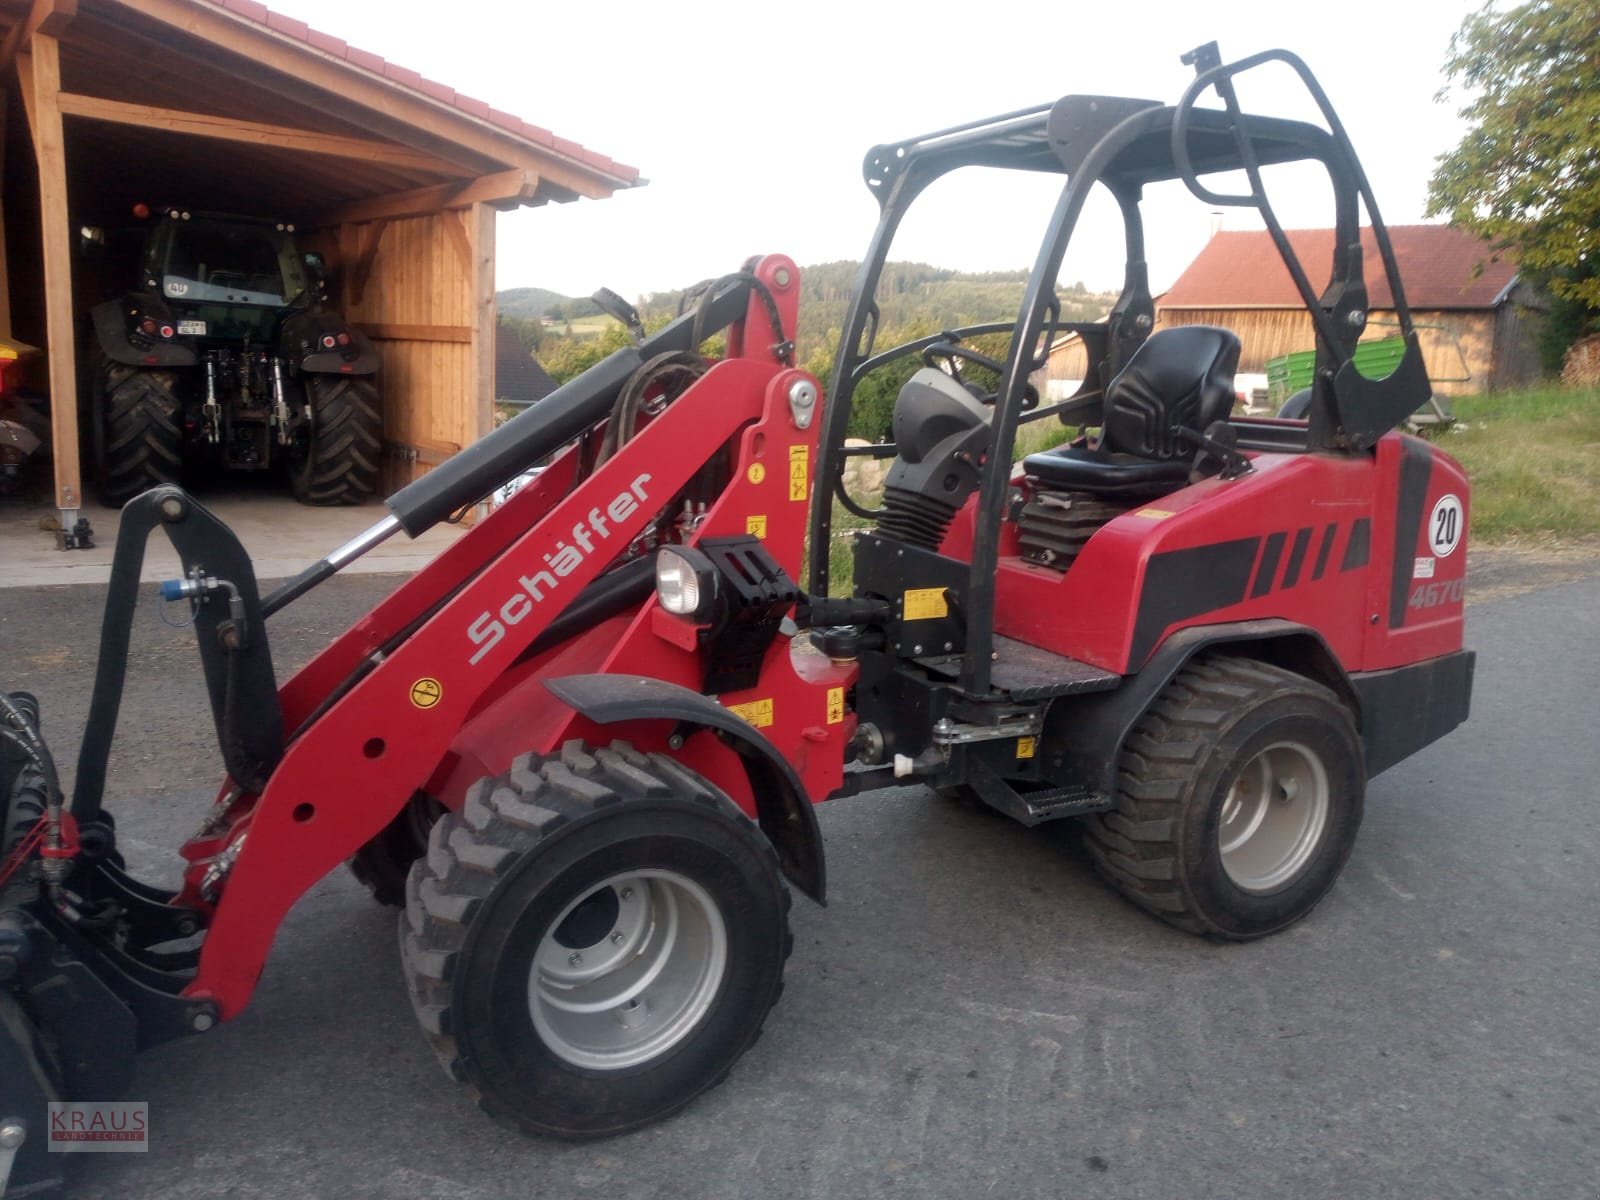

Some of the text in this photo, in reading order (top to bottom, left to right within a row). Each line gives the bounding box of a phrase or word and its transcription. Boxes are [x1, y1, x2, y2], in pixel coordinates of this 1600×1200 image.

[1435, 507, 1457, 545] 20
[467, 473, 652, 666] Schäffer
[1408, 579, 1464, 609] 4670
